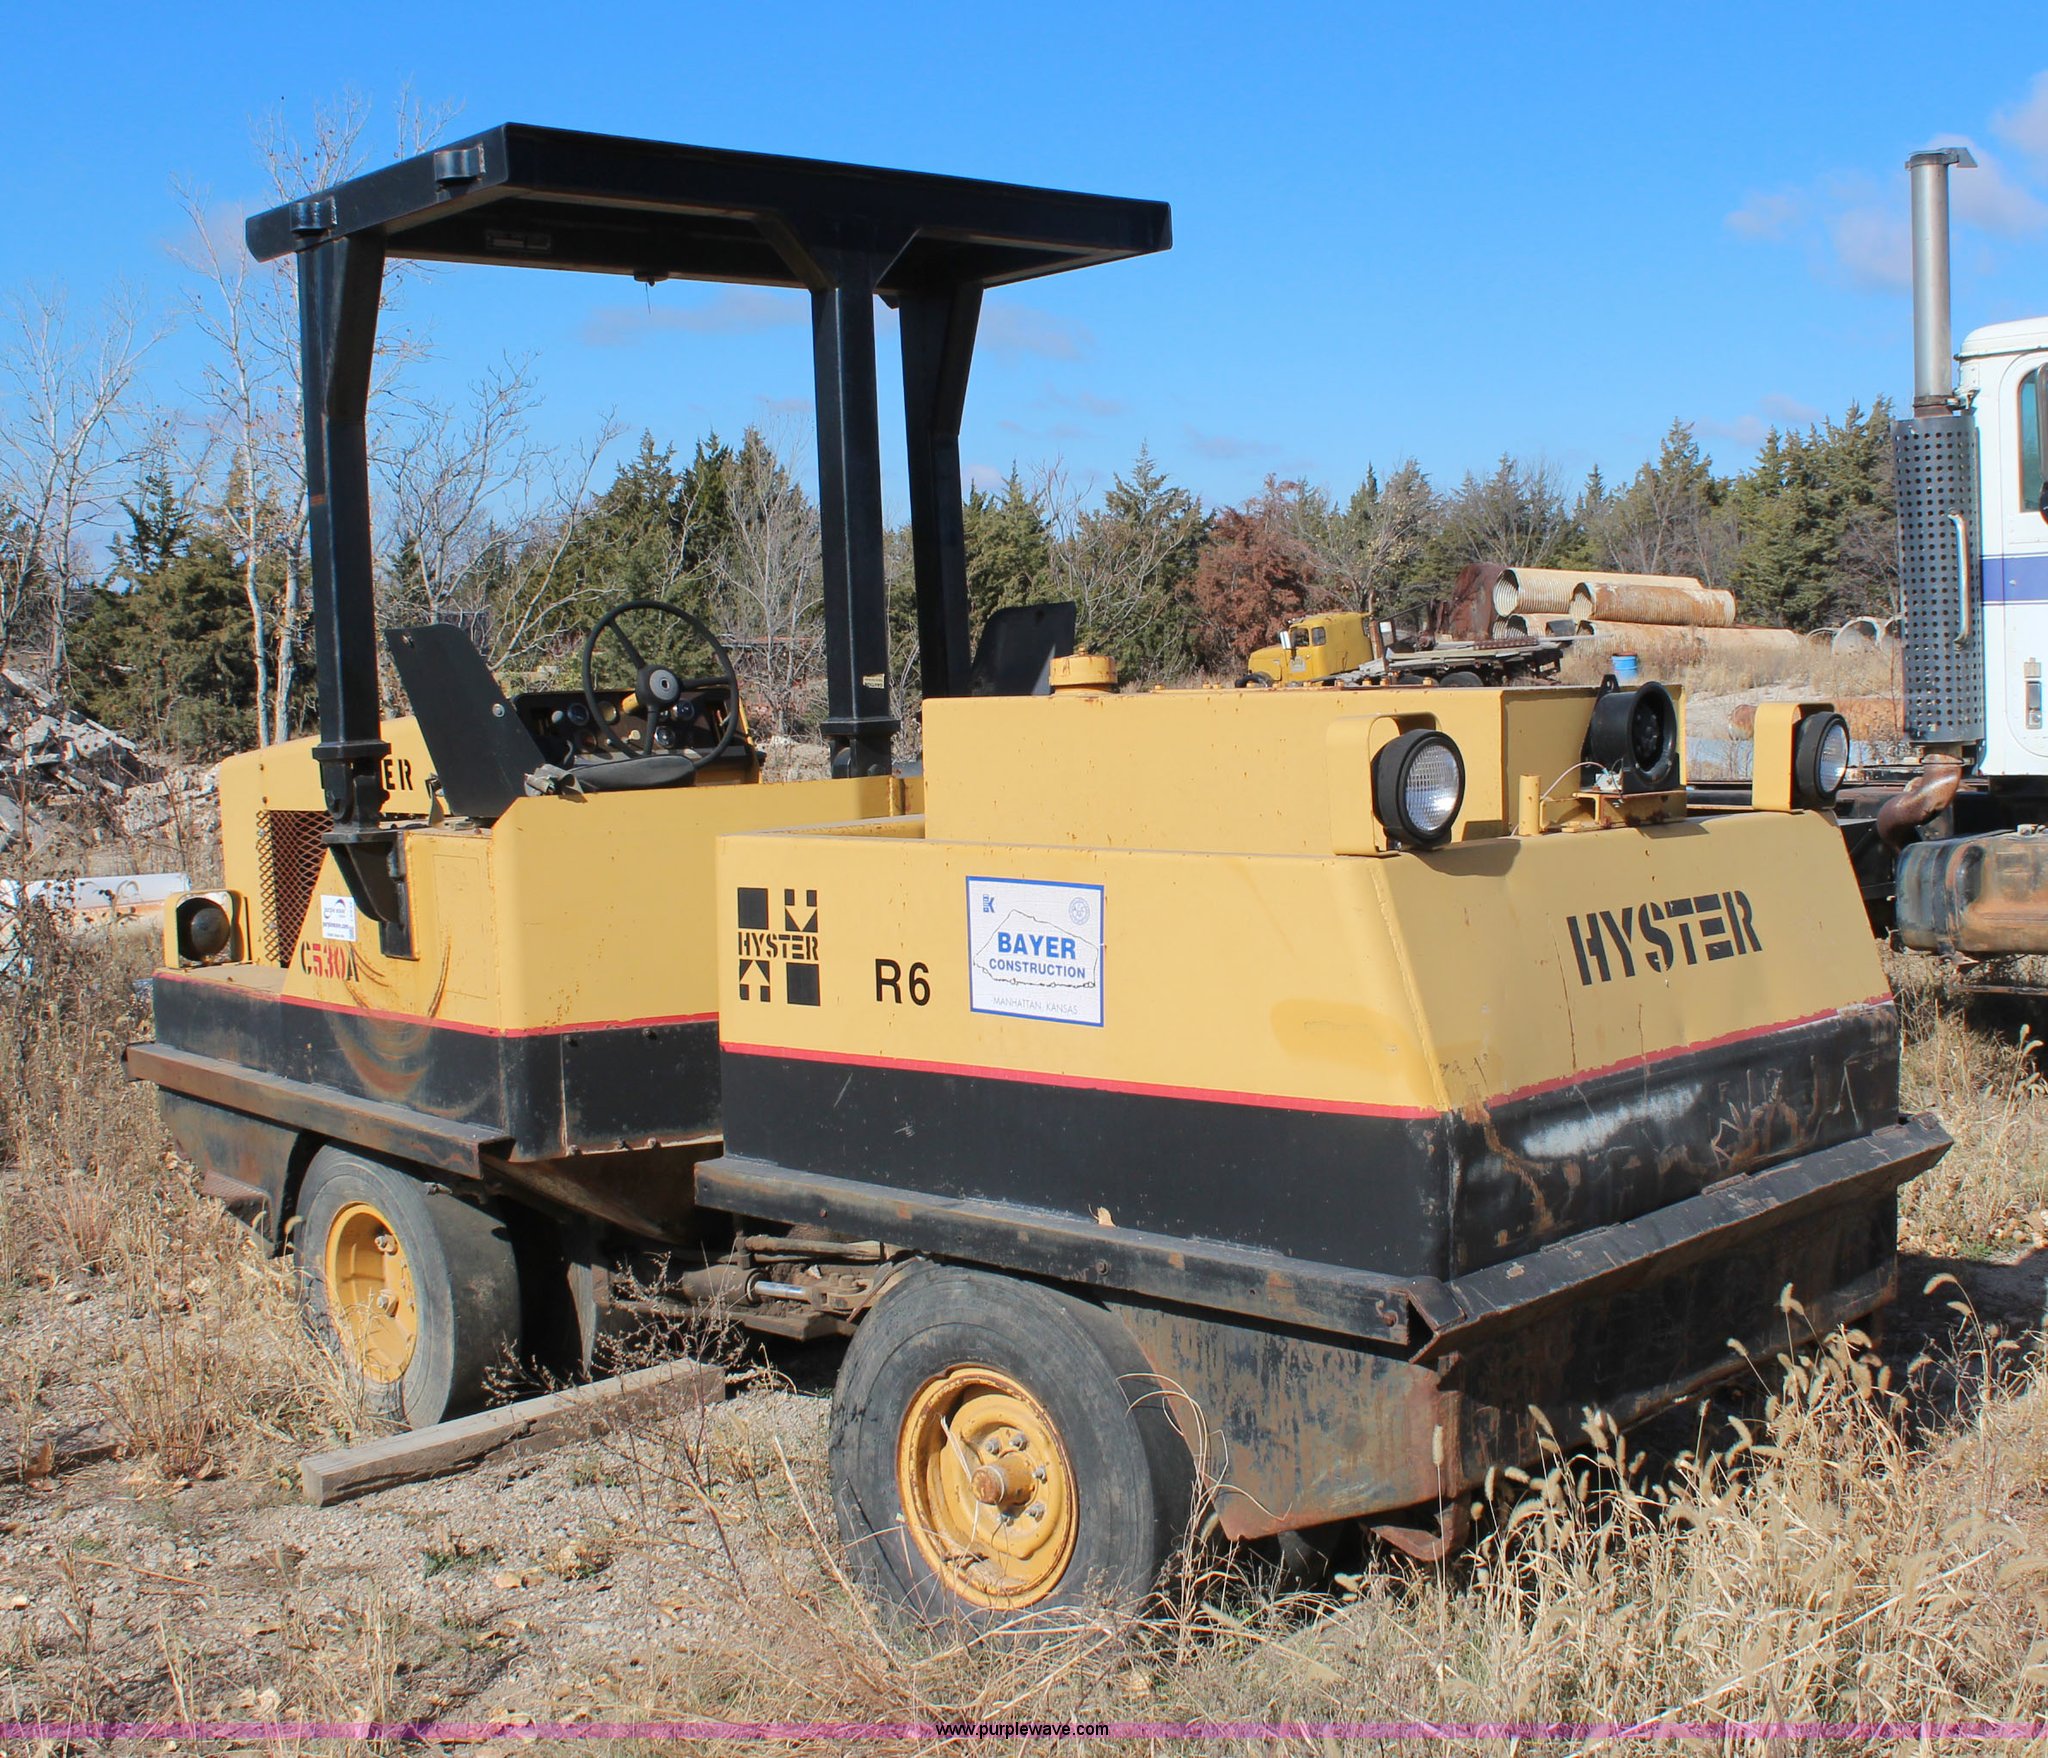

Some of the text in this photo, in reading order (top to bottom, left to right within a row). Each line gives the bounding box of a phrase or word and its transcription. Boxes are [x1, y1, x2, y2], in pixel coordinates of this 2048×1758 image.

[738, 931, 819, 961] HYSTER
[997, 931, 1076, 960] BAYER
[1566, 890, 1763, 986] HYSTER
[300, 941, 360, 982] C530A
[988, 958, 1086, 979] CONSTRUCTION
[875, 958, 931, 1007] R6
[1045, 1001, 1079, 1015] KANSAS
